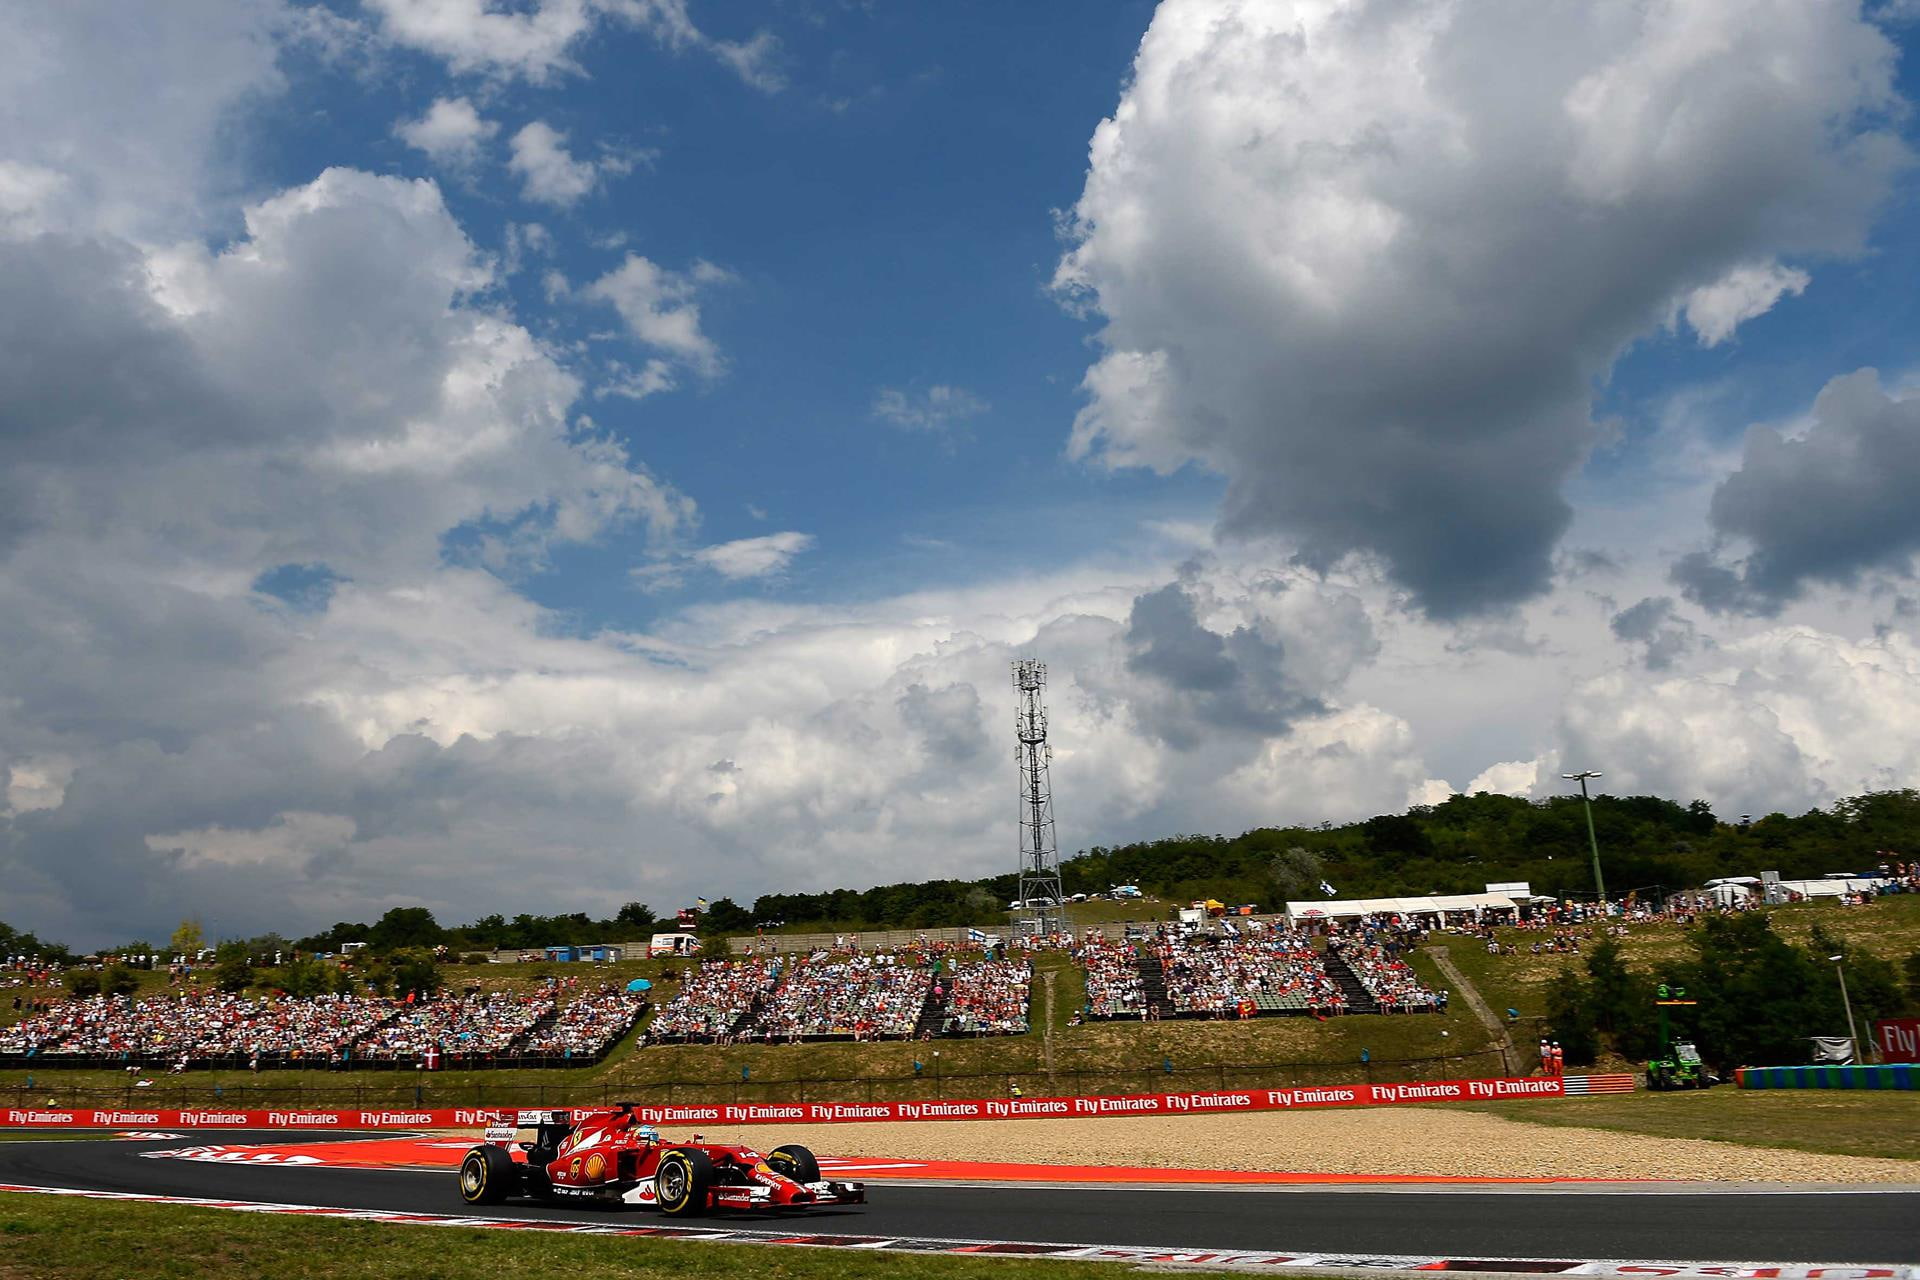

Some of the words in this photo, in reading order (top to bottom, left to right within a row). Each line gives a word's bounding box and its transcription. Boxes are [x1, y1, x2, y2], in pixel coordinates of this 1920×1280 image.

[1883, 1025, 1916, 1058] Fly
[1371, 1086, 1395, 1101] Fly
[1398, 1084, 1461, 1098] Emirates
[1469, 1081, 1493, 1096] Fly
[1496, 1079, 1560, 1093] Emirates
[1075, 1099, 1098, 1114] Fly
[1100, 1097, 1159, 1111] Emirates
[1166, 1096, 1189, 1111] Fly
[1191, 1094, 1251, 1107] Emirates
[1268, 1092, 1291, 1107] Fly
[1293, 1089, 1355, 1103] Emirates
[641, 1108, 663, 1122] Fly
[665, 1107, 718, 1120] Emirates
[726, 1106, 747, 1120] Fly
[749, 1105, 803, 1119] Emirates
[811, 1105, 833, 1120] Fly
[835, 1104, 890, 1118] Emirates
[898, 1104, 920, 1118] Fly
[922, 1103, 978, 1116] Emirates
[986, 1101, 1008, 1117] Fly
[1010, 1100, 1068, 1114] Emirates
[9, 1111, 27, 1124] Fly
[28, 1111, 73, 1123] Emirates
[94, 1111, 112, 1125] Fly
[113, 1111, 159, 1123] Emirates
[180, 1112, 198, 1125] Fly
[200, 1112, 247, 1124] Emirates
[268, 1112, 288, 1126] Fly
[289, 1112, 338, 1124] Emirates
[360, 1112, 380, 1126] Fly
[382, 1112, 432, 1124] Emirates
[456, 1110, 475, 1124] Fly
[740, 1151, 759, 1159] 14
[724, 1191, 750, 1202] Santander
